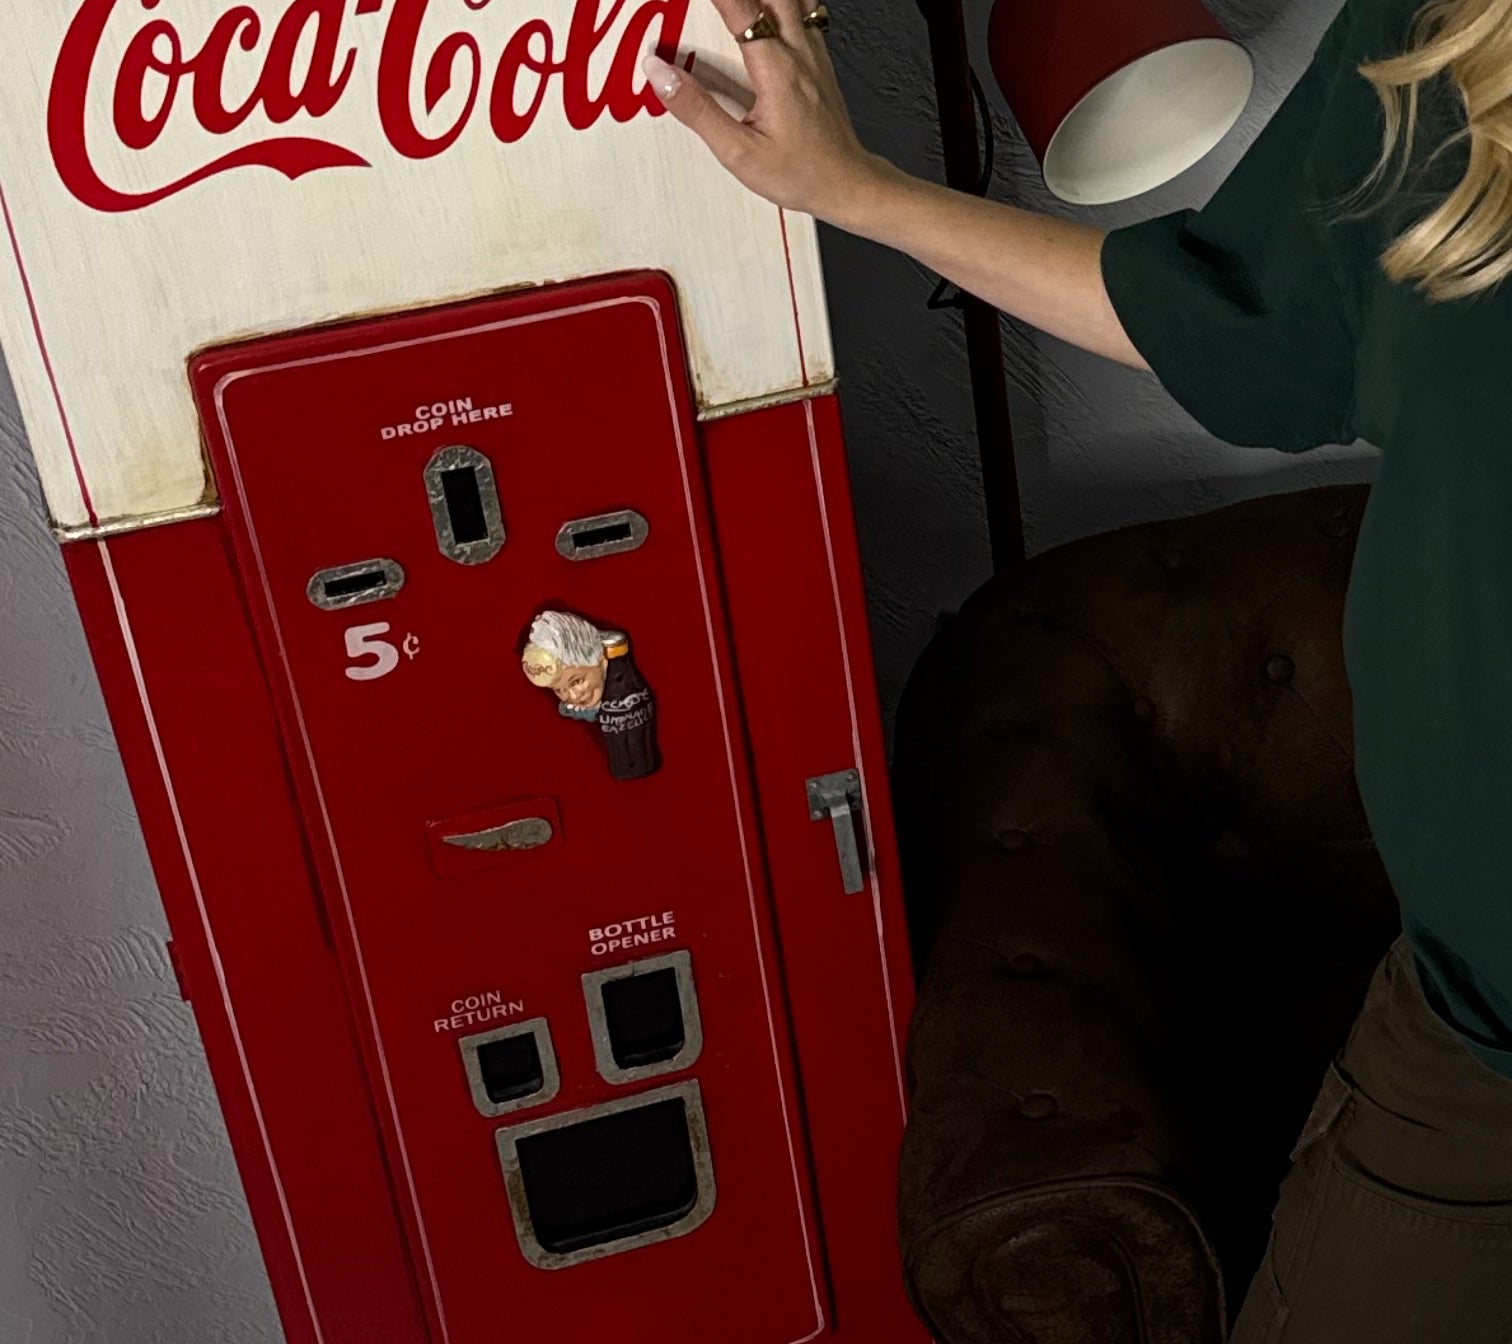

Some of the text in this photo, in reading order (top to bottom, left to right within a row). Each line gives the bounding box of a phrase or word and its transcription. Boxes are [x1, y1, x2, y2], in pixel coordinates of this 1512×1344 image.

[380, 402, 514, 441] DROP HERE
[415, 396, 473, 420] COIN
[588, 910, 676, 942] BOTTLE
[590, 926, 677, 957] OPENER
[433, 999, 525, 1034] RETURN
[450, 989, 502, 1015] COIN
